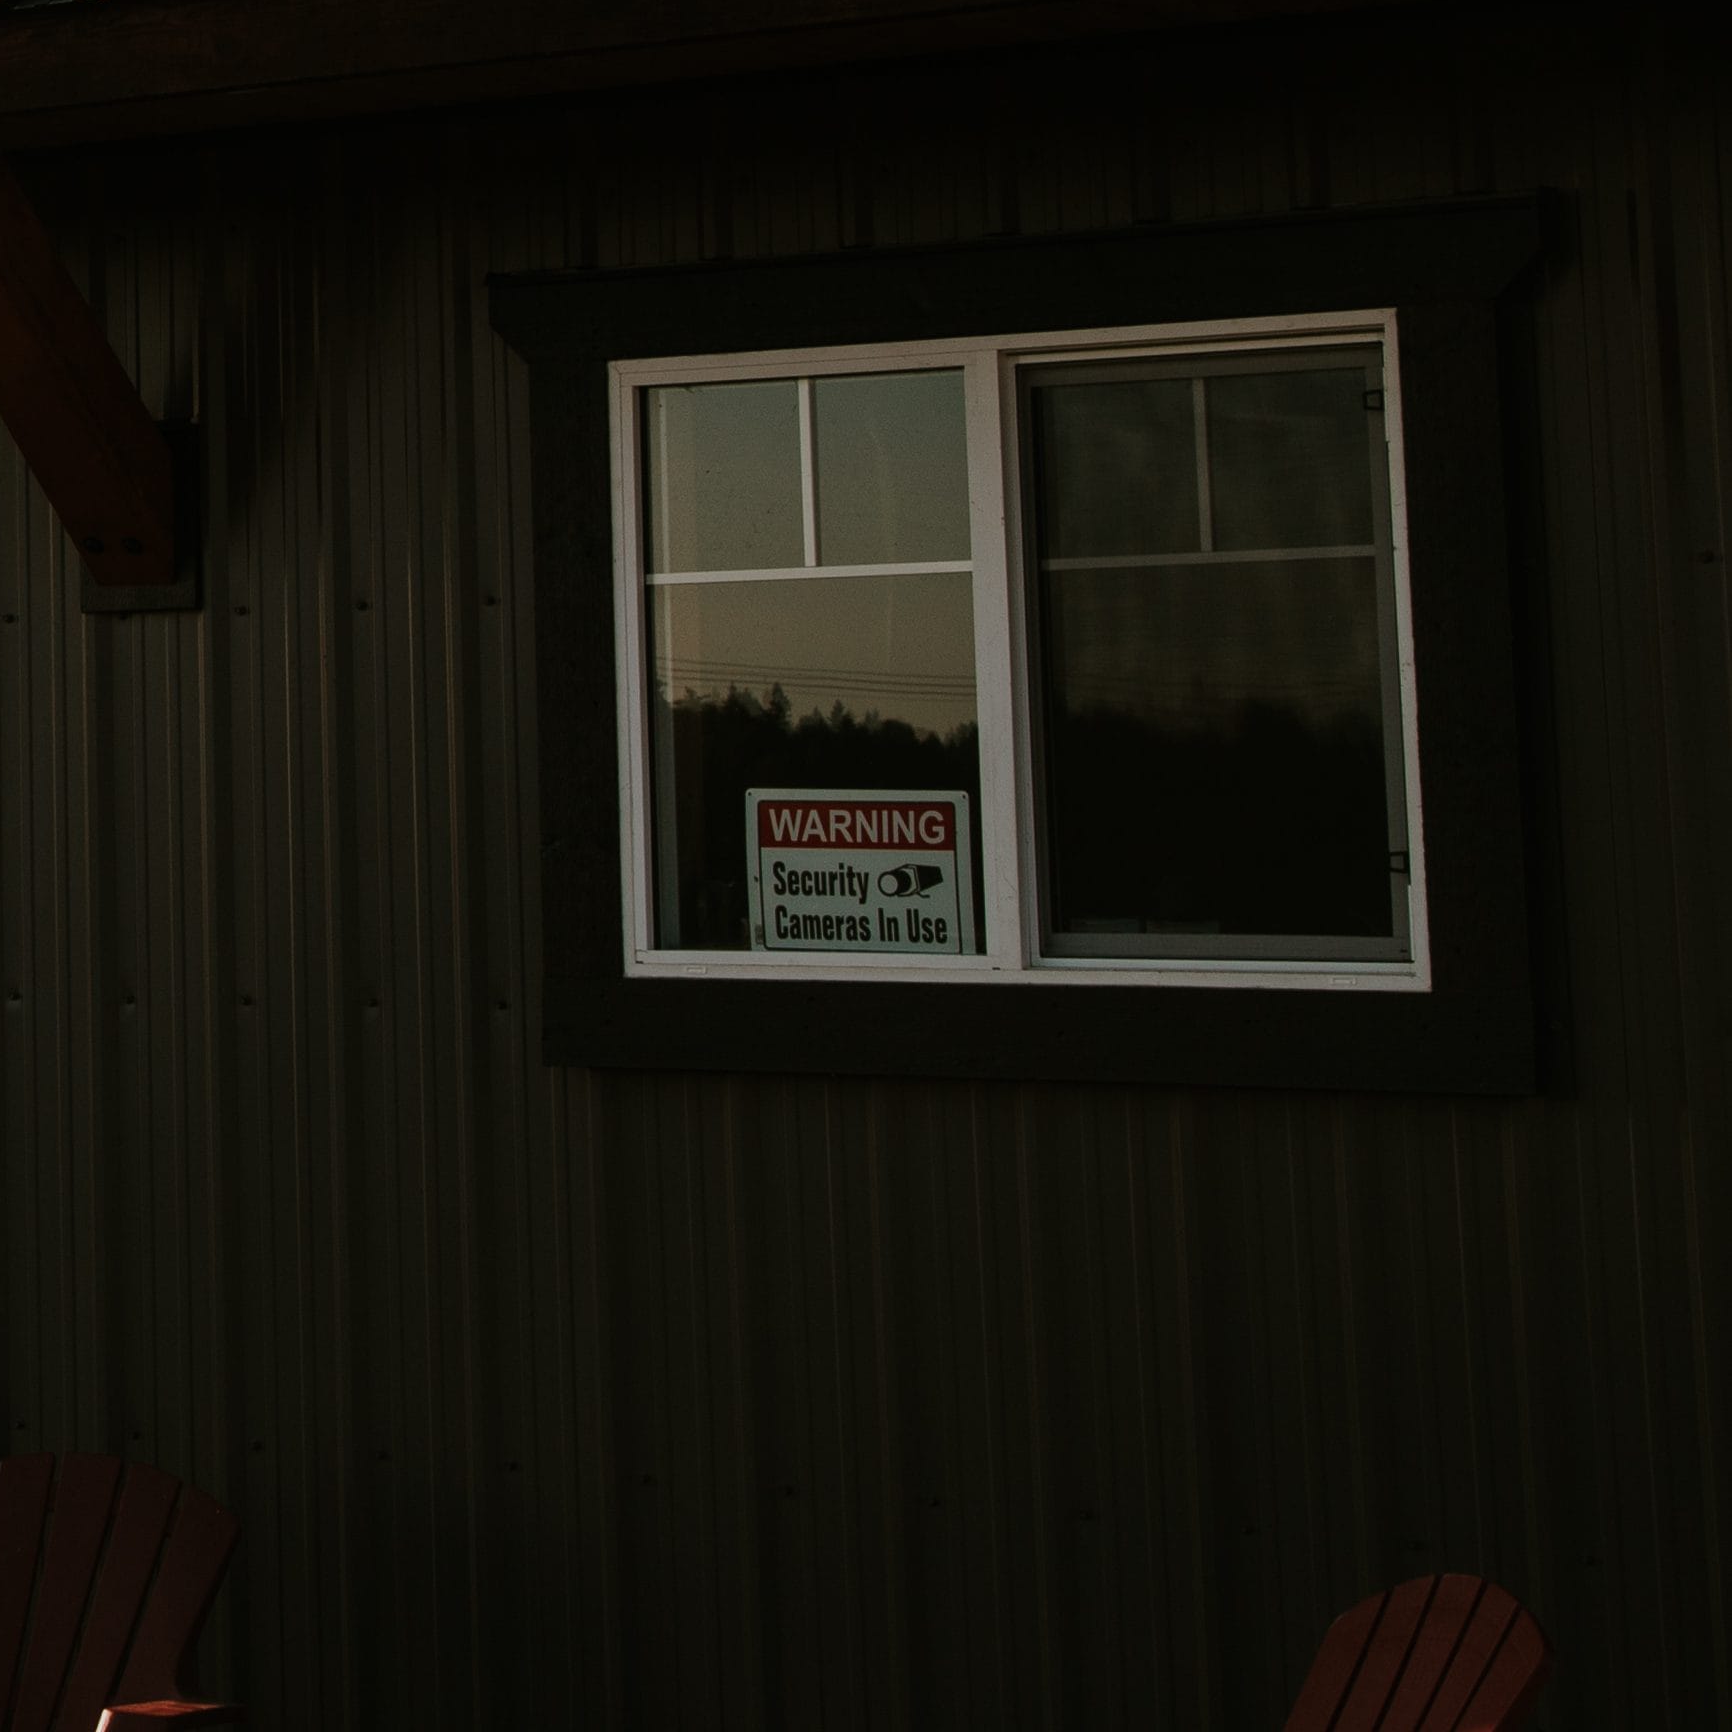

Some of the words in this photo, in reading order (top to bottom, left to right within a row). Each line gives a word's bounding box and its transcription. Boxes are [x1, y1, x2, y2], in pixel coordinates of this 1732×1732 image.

[768, 808, 946, 845] WARNING
[772, 860, 870, 905] Security
[774, 904, 872, 943] Cameras
[877, 907, 900, 943] In
[906, 908, 948, 946] Use
